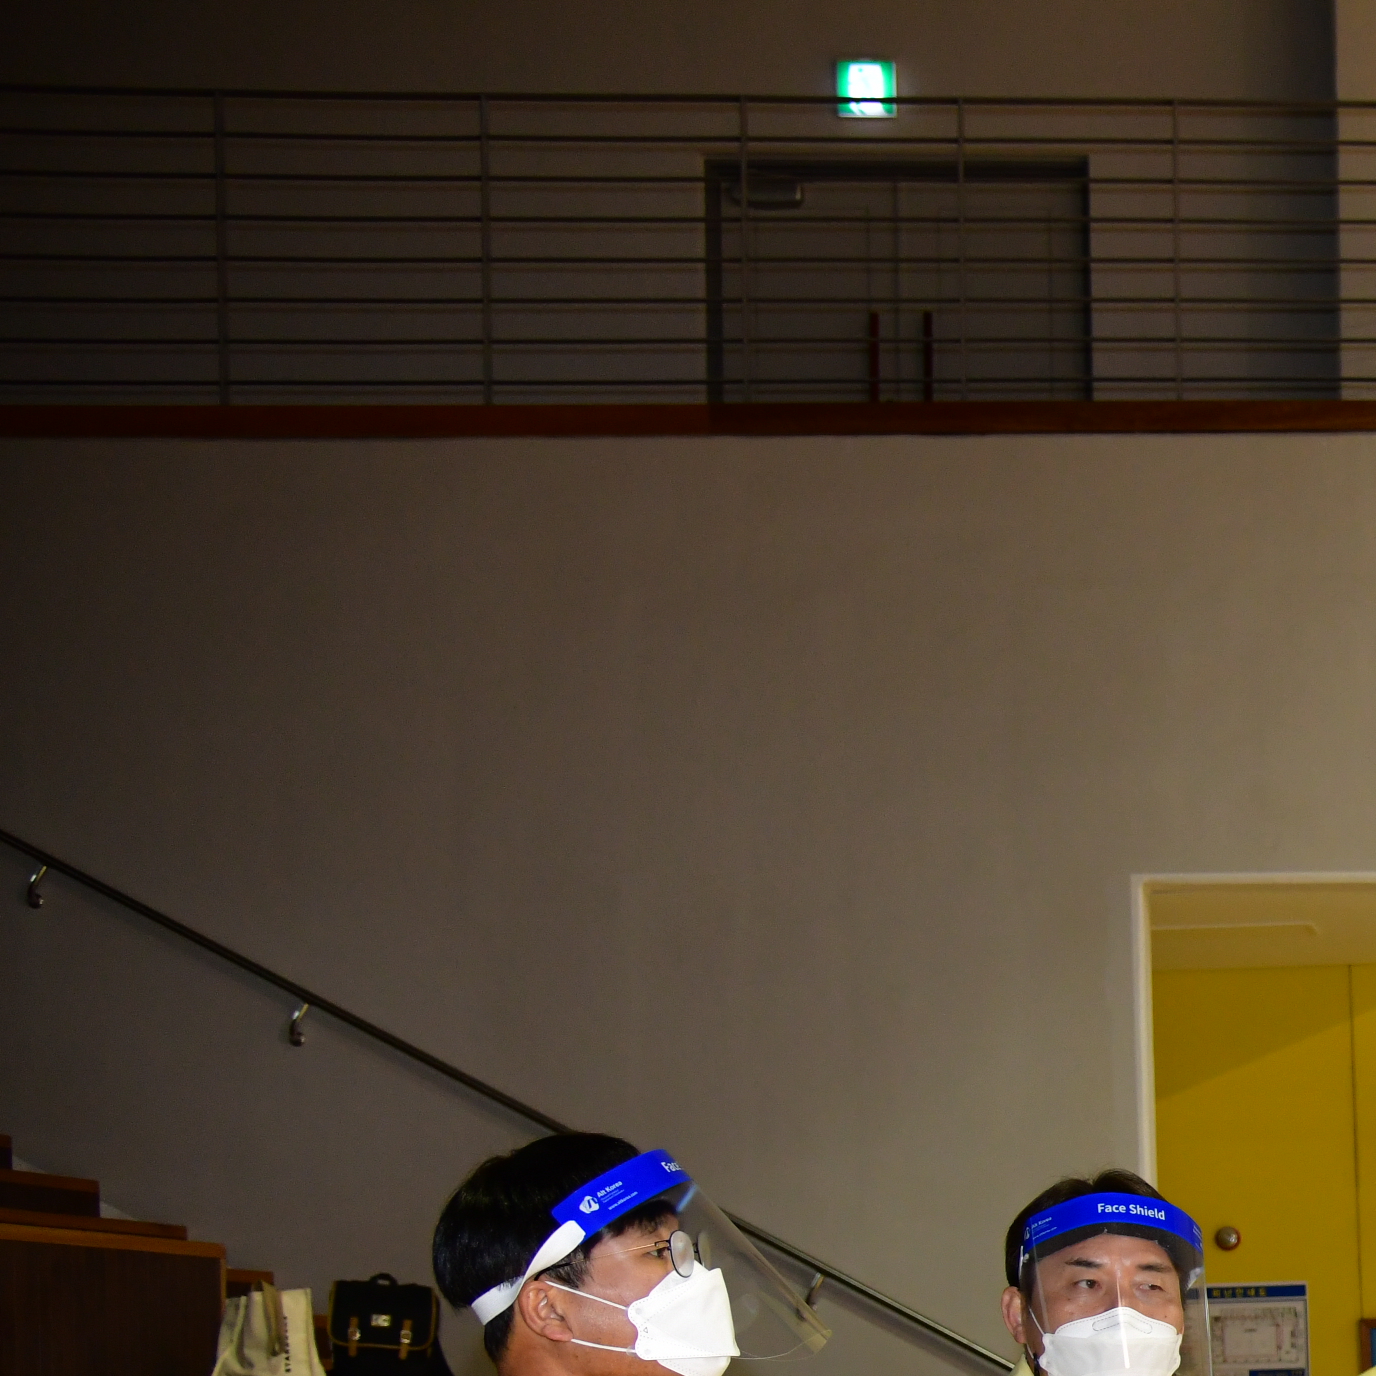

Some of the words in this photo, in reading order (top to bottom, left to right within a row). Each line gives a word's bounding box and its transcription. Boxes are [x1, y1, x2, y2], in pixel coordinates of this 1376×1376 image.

[597, 1189, 606, 1198] Alt
[606, 1181, 623, 1193] Korea
[1098, 1203, 1127, 1214] Face
[1129, 1204, 1166, 1220] Shield
